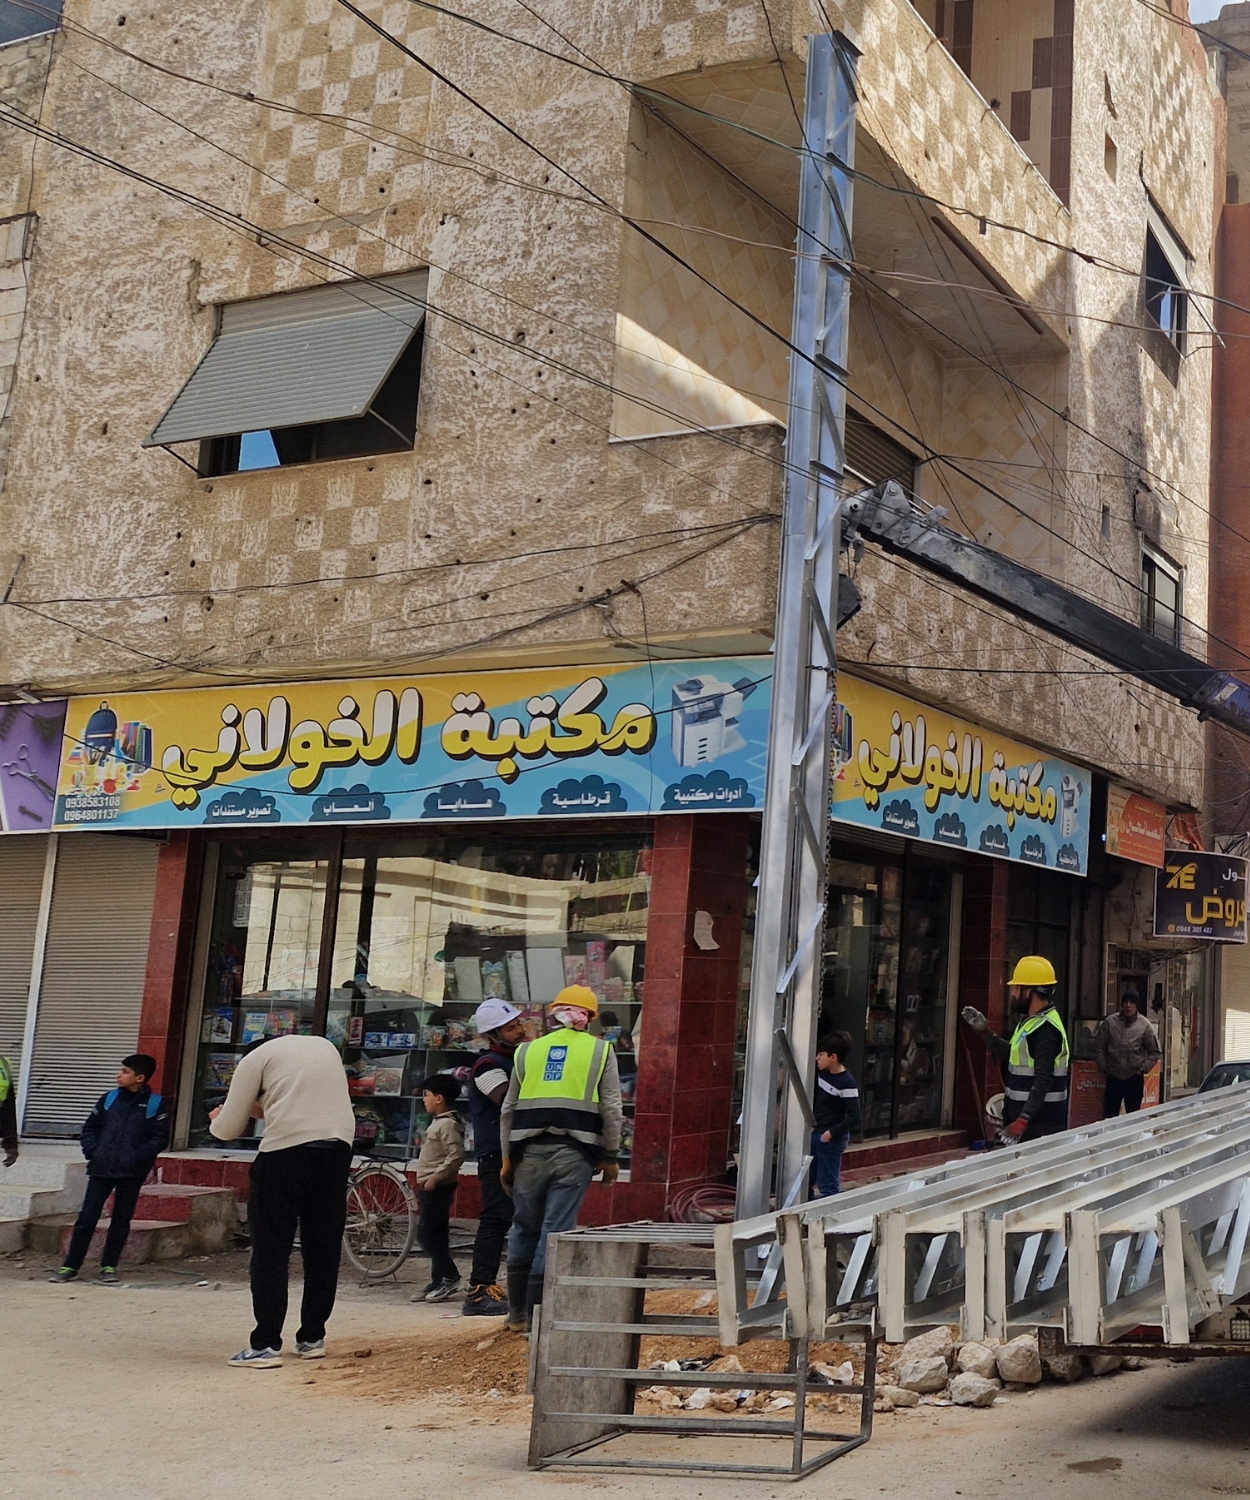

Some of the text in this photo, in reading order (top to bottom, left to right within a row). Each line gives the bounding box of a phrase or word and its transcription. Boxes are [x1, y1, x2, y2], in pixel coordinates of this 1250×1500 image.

[162, 677, 656, 810] مكتبة الخولاني
[858, 711, 1057, 831] مكتبة الخولاني
[552, 790, 611, 806] قرطاسية
[674, 785, 742, 805] أدوات مكتبية
[212, 803, 272, 818] تصوير مستندات
